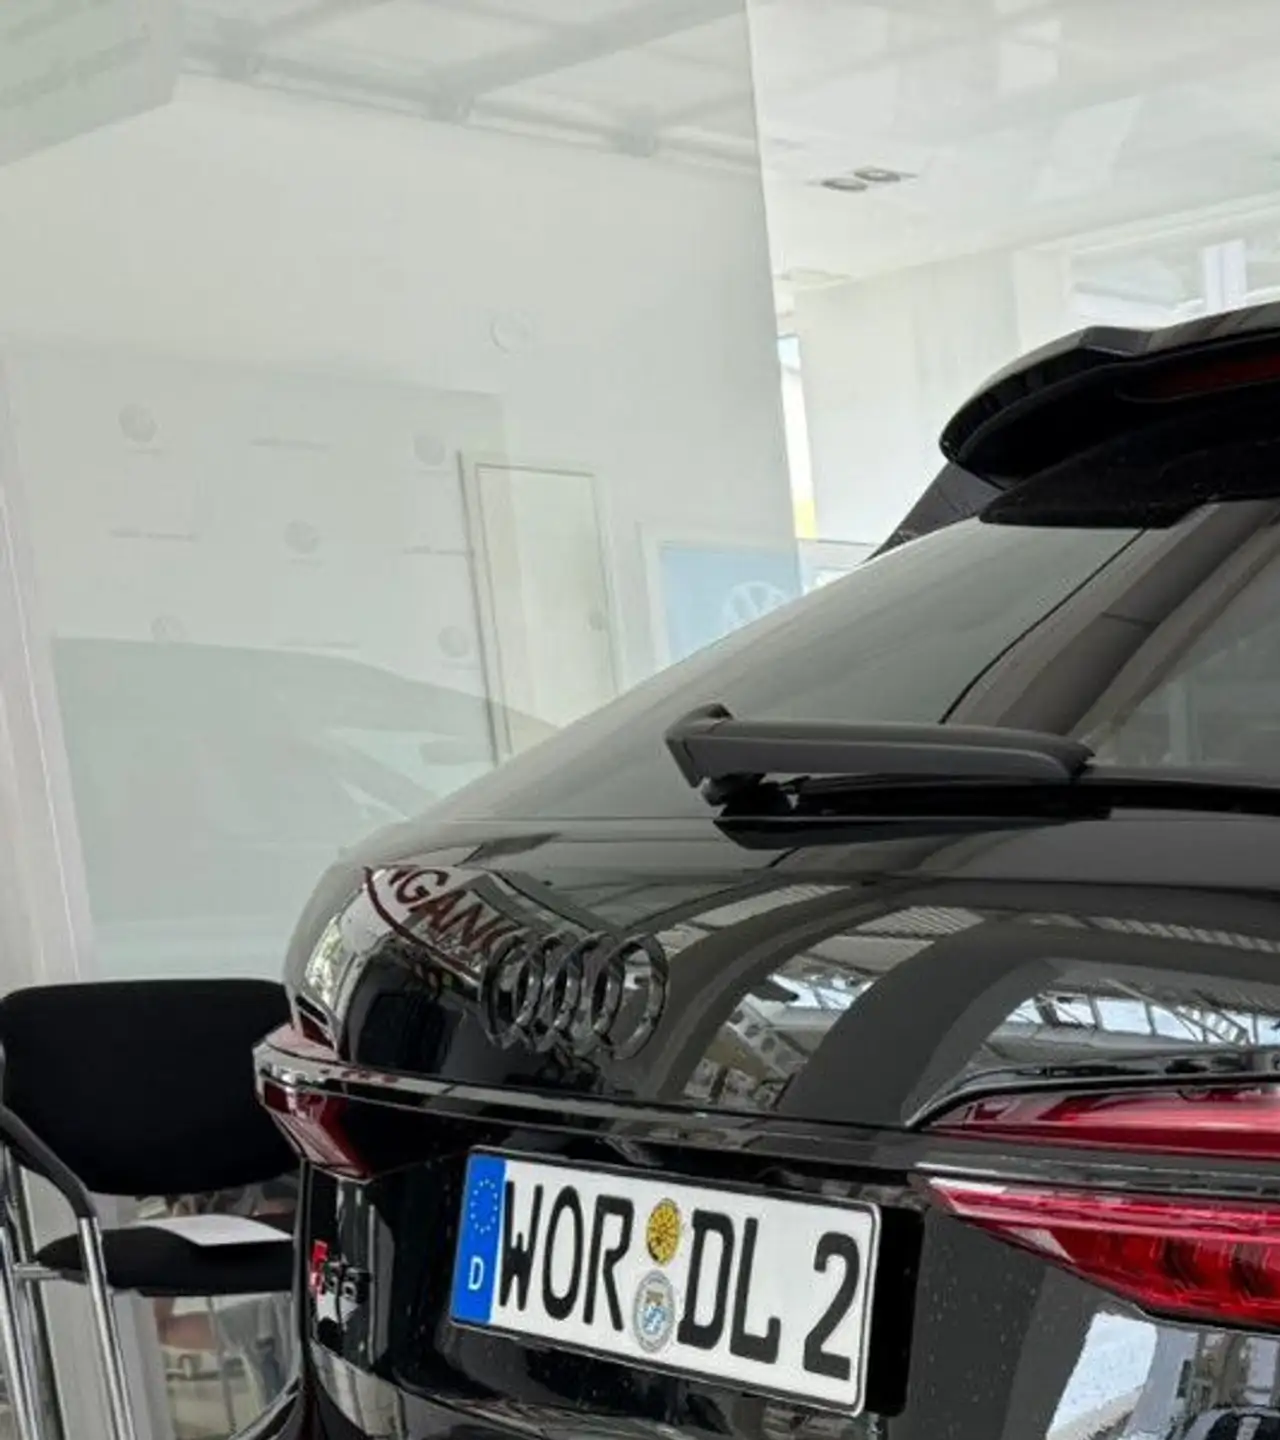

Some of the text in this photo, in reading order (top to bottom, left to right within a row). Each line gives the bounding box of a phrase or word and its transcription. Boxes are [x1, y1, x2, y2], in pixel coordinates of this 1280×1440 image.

[467, 1256, 485, 1291] D
[499, 1180, 860, 1382] WOR DL 2
